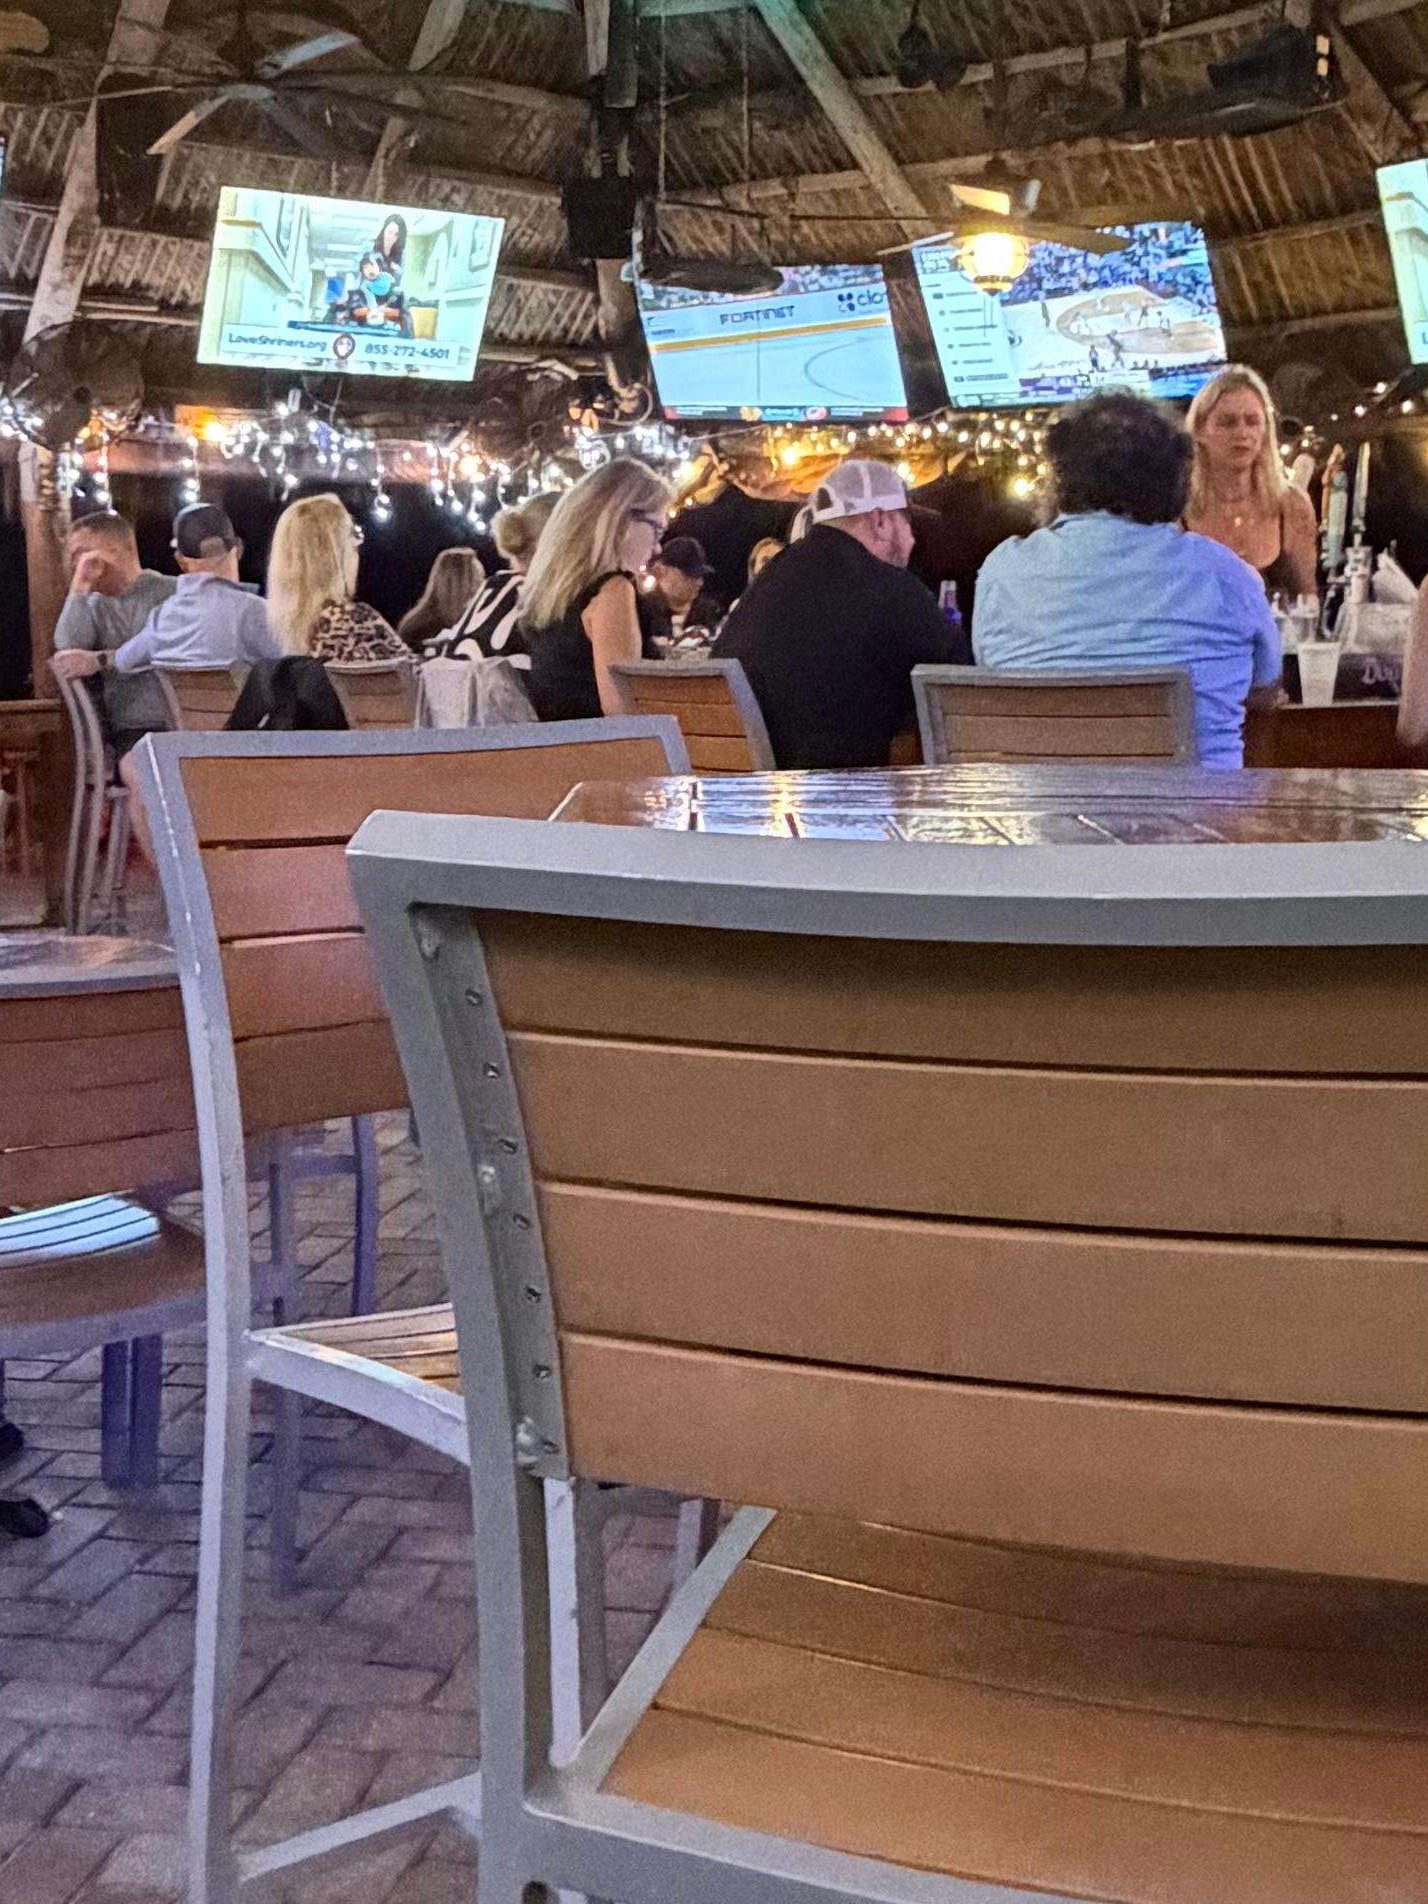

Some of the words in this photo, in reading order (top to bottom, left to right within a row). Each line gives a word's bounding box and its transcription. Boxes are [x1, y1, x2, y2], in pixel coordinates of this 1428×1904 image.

[857, 288, 888, 307] clo
[719, 305, 796, 325] FORTINET
[364, 342, 451, 361] 855-272-4501
